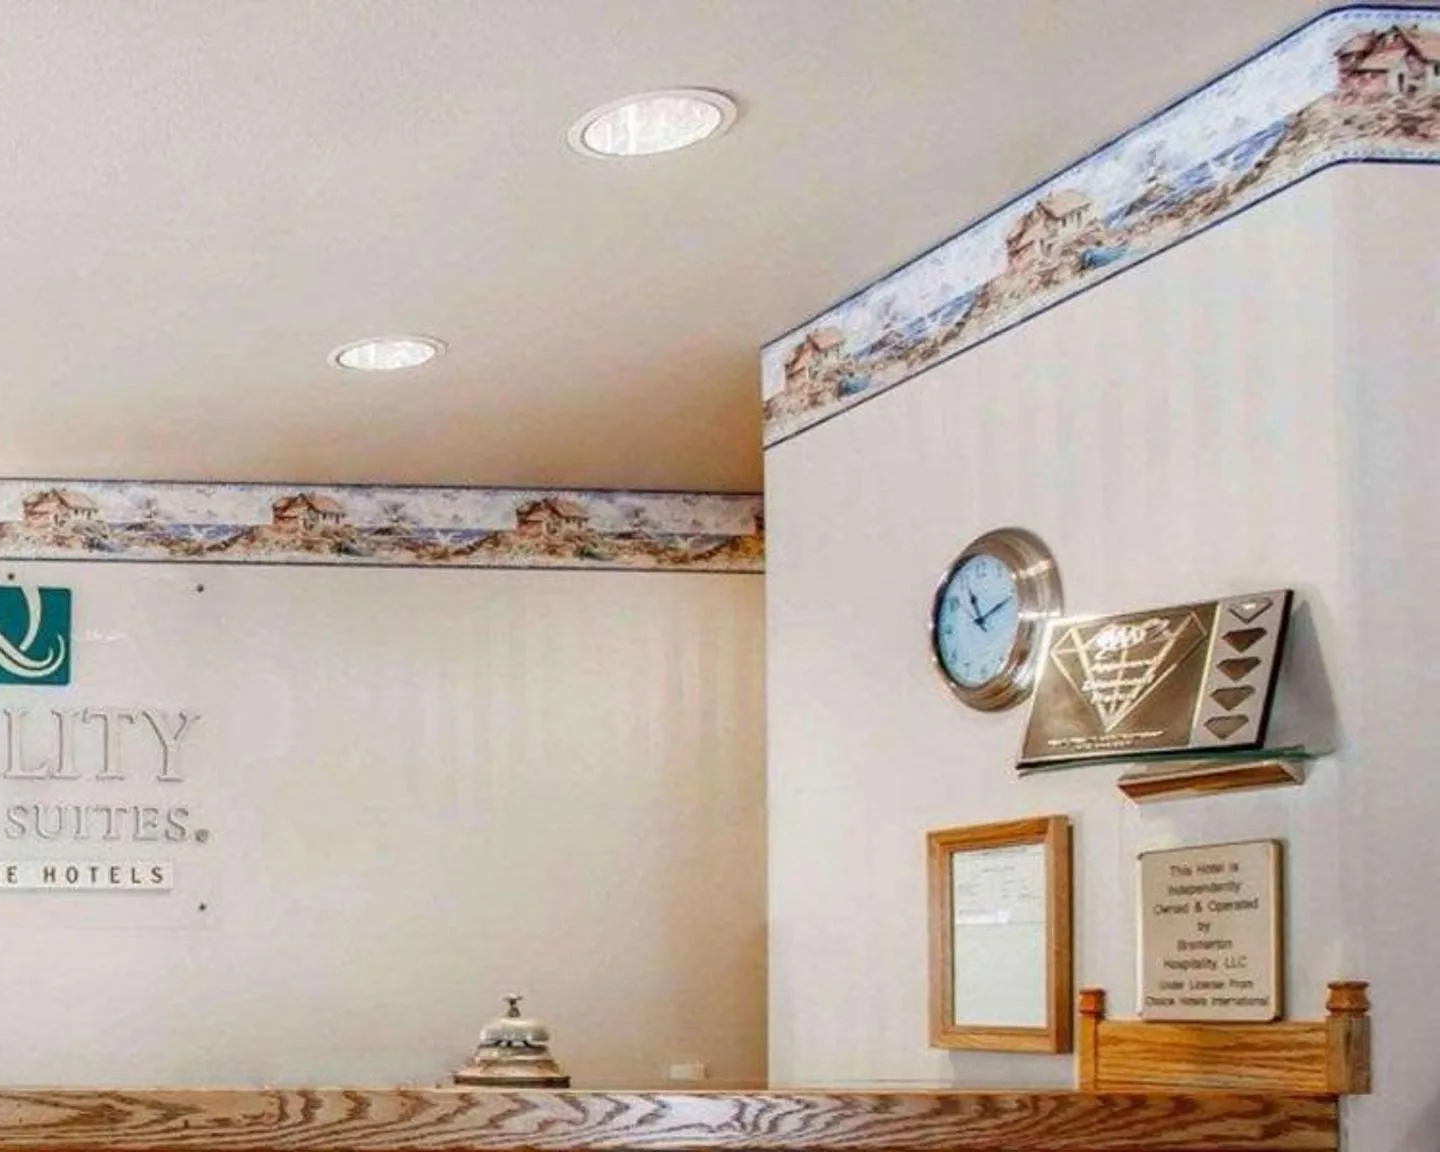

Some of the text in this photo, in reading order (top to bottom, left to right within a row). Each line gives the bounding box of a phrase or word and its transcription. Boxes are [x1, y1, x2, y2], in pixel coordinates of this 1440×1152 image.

[43, 866, 166, 884] HOTELS
[1169, 864, 1192, 877] This
[1208, 898, 1259, 913] Operated
[1196, 921, 1211, 933] by
[1223, 955, 1248, 969] LLC
